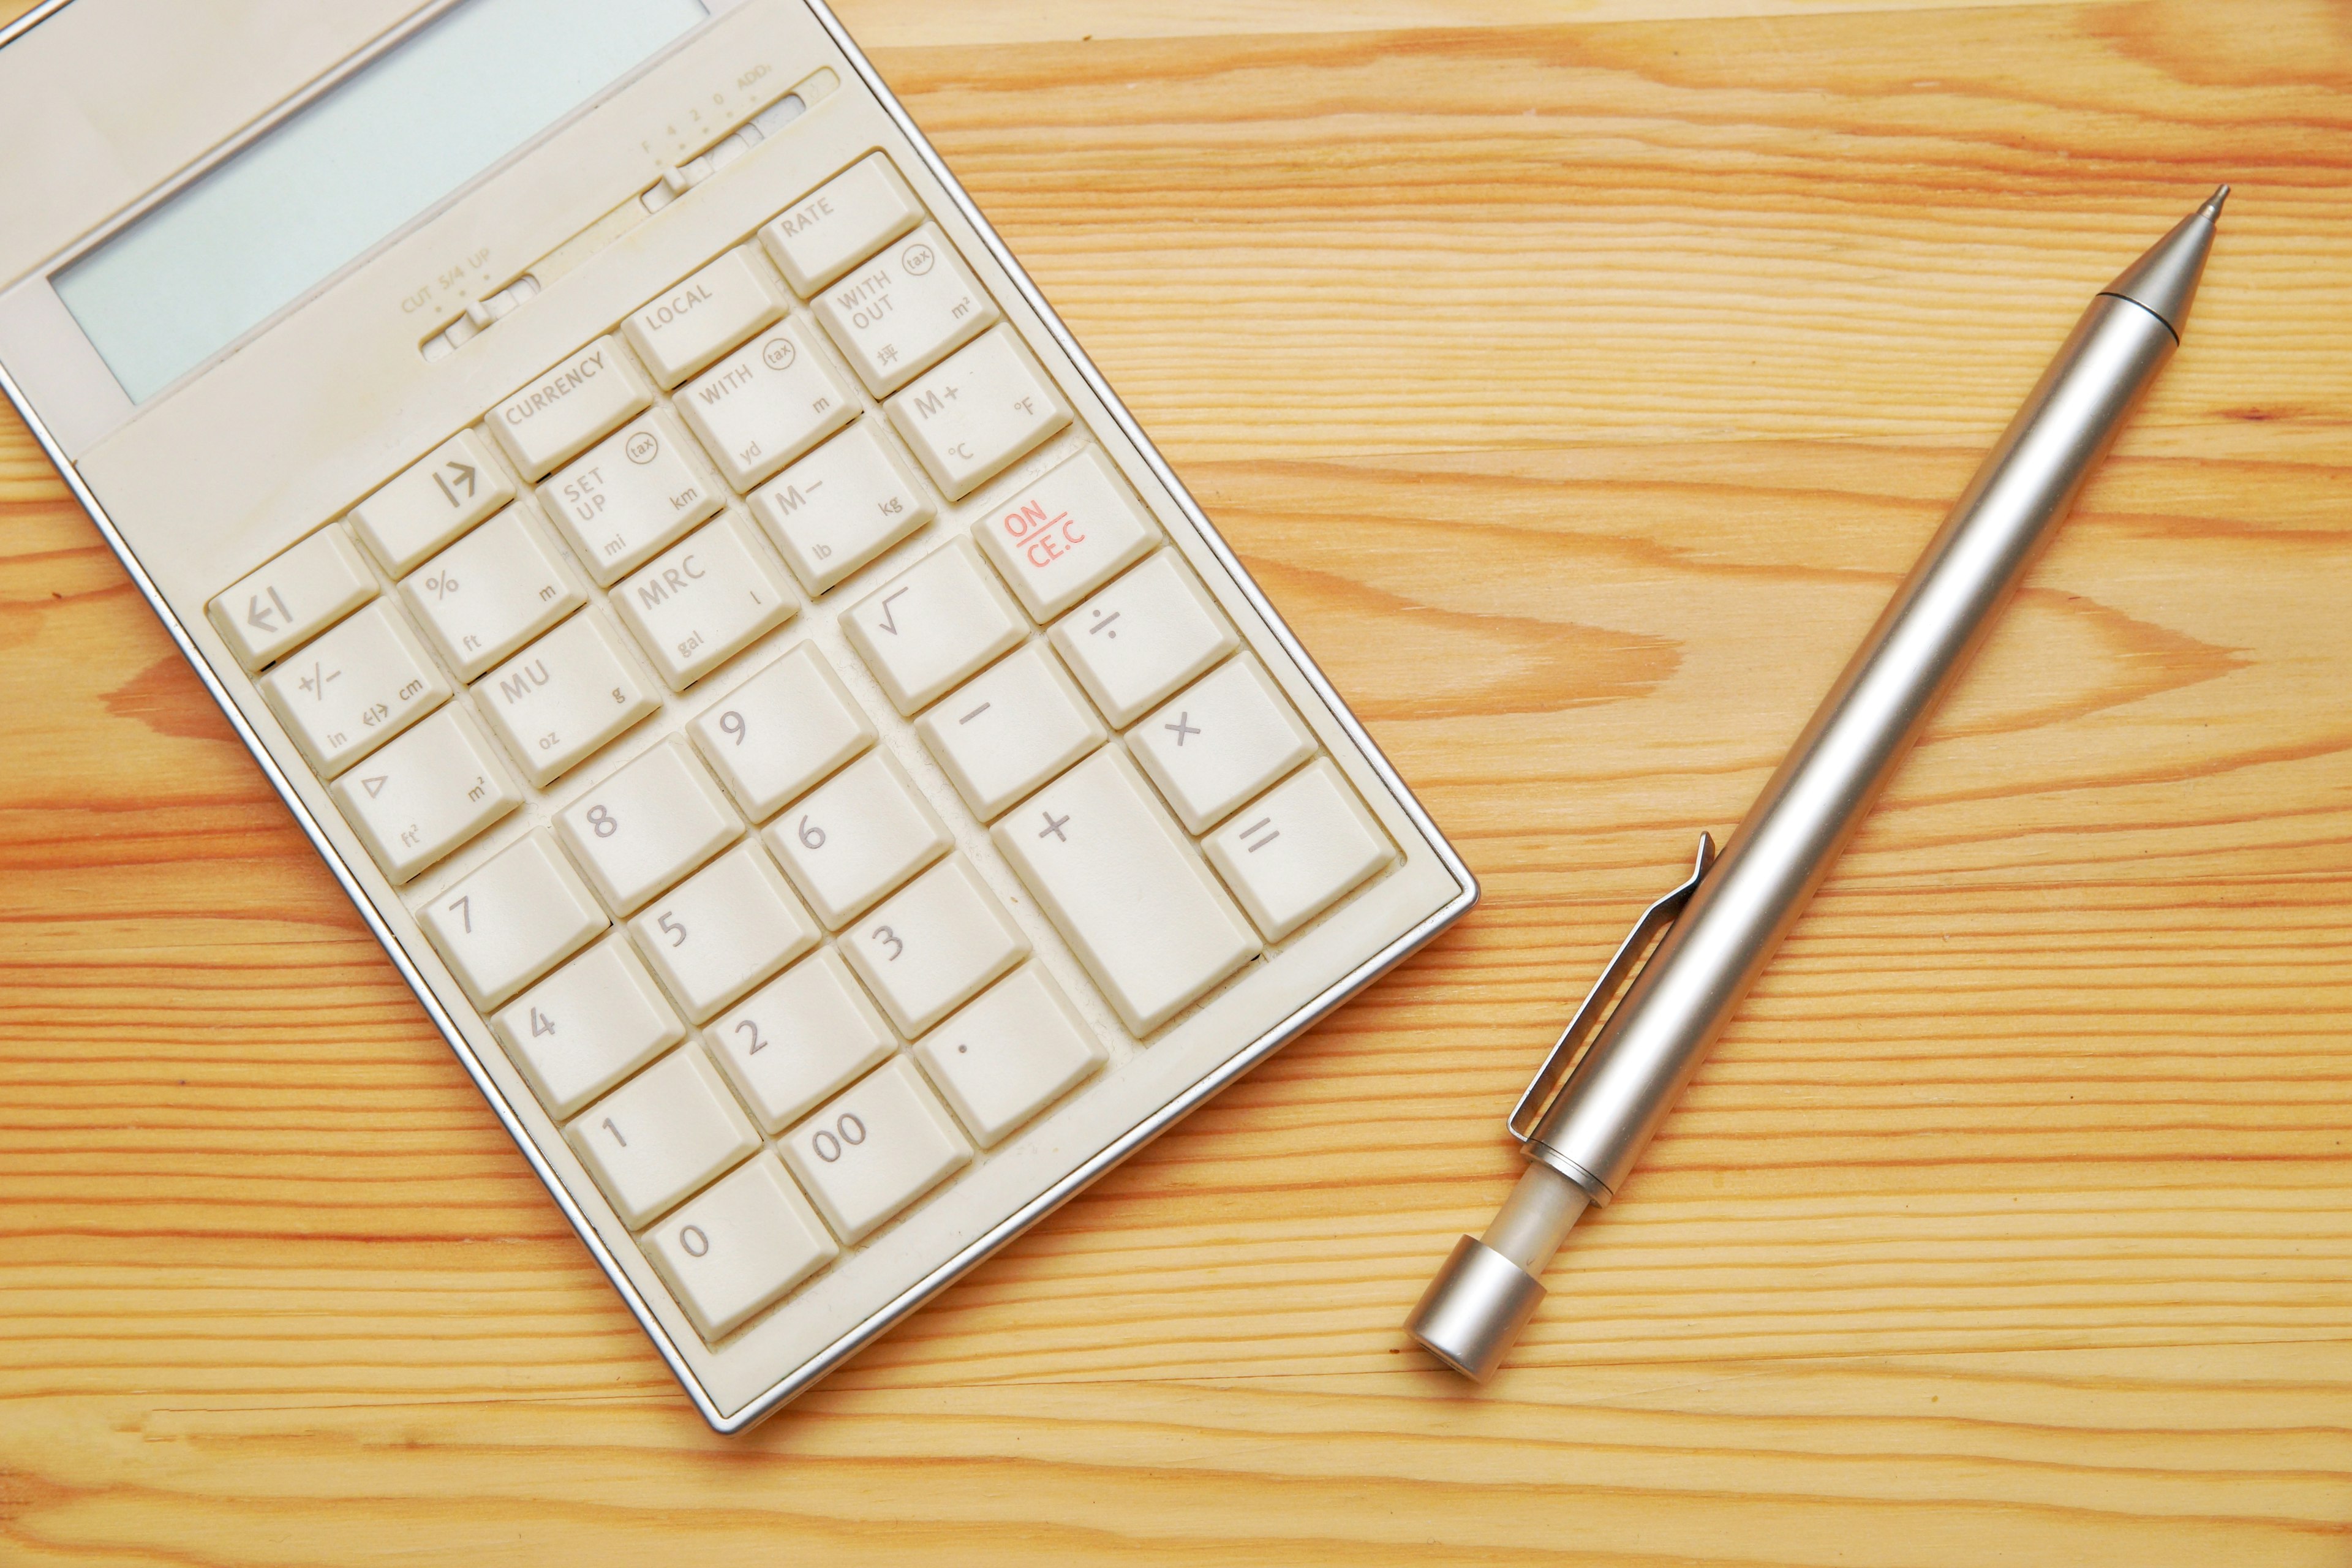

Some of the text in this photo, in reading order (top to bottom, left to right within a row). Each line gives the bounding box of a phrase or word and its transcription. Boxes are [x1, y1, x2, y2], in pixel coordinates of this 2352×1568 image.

[668, 126, 676, 135] 4
[713, 94, 723, 104] 0
[781, 198, 834, 237] RATE
[907, 251, 930, 269] tax
[401, 247, 489, 314] CUT 5/4 UP
[837, 270, 892, 311] WITH
[646, 285, 713, 331] LOCAL
[853, 294, 894, 329] OUT
[768, 345, 791, 363] tax
[877, 344, 898, 366] 坪
[505, 352, 605, 425] CURRENCY
[699, 364, 753, 405] WITH
[812, 398, 829, 413] m
[913, 386, 958, 419] M+
[631, 440, 654, 457] tax
[740, 441, 761, 464] yd
[564, 467, 605, 502] SET
[669, 488, 697, 510] km
[576, 494, 605, 521] UP
[878, 497, 903, 516] kg
[1005, 500, 1047, 537] ON
[604, 533, 626, 556] mi
[812, 544, 832, 560] lb
[424, 570, 459, 600] %
[539, 586, 556, 601] m
[638, 555, 706, 610] MRC
[462, 635, 481, 652] ft
[677, 630, 704, 658] gal
[399, 679, 423, 701] cm
[500, 659, 549, 704] MU
[612, 688, 625, 704] g
[327, 733, 347, 748] in
[539, 732, 560, 750] oz
[719, 711, 745, 745] 9
[586, 805, 617, 838] 8
[798, 815, 826, 850] 6
[449, 895, 471, 933] 7
[657, 911, 687, 948] 5
[872, 925, 903, 962] 3
[530, 1007, 555, 1038] 4
[735, 1020, 768, 1055] 2
[602, 1118, 627, 1147] 1
[813, 1114, 866, 1163] 00
[679, 1225, 709, 1258] 0
